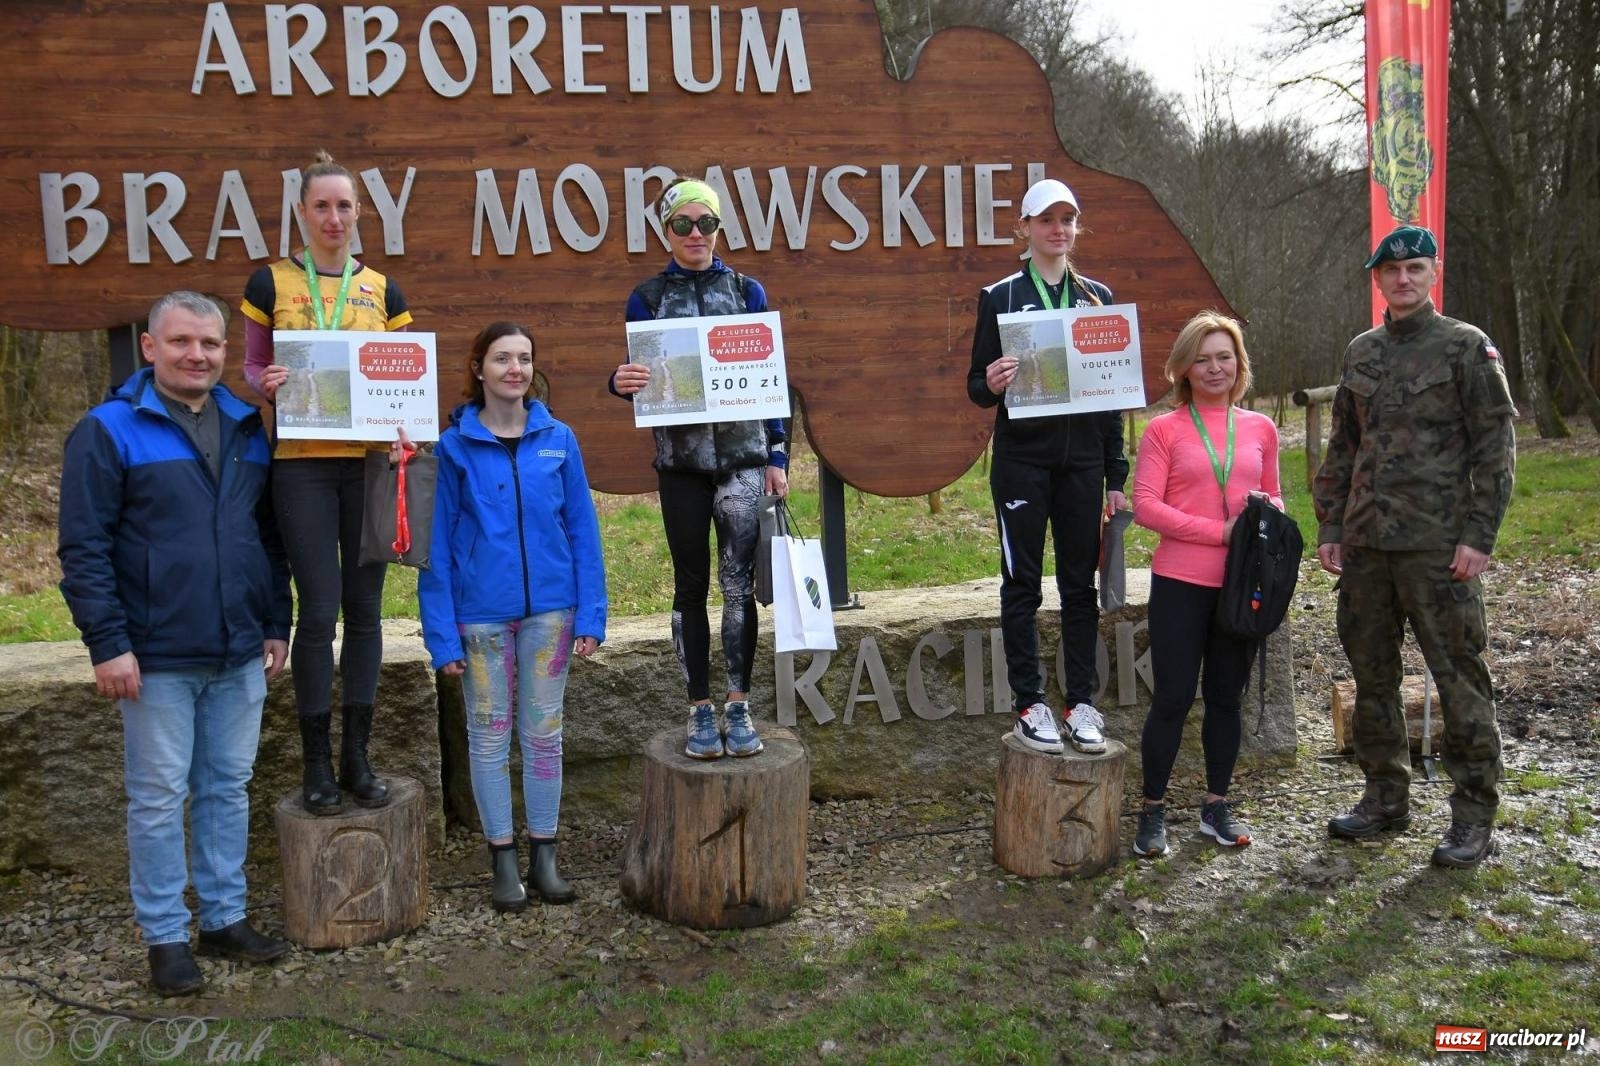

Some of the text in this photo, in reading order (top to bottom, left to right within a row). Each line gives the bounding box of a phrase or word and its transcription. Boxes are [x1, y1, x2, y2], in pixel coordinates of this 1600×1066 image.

[191, 1, 811, 98] ARBORETUM
[739, 339, 761, 347] BIEG
[1074, 337, 1128, 346] TWARDZIELA
[710, 345, 771, 355] TWARDZIELA
[360, 365, 424, 373] TWARDZIELA
[1081, 359, 1131, 369] VOUCHER
[711, 377, 748, 391] 500
[367, 388, 425, 396] VOUCHER
[1049, 778, 1100, 868] 3
[698, 805, 762, 909] 1
[321, 826, 391, 927] 2
